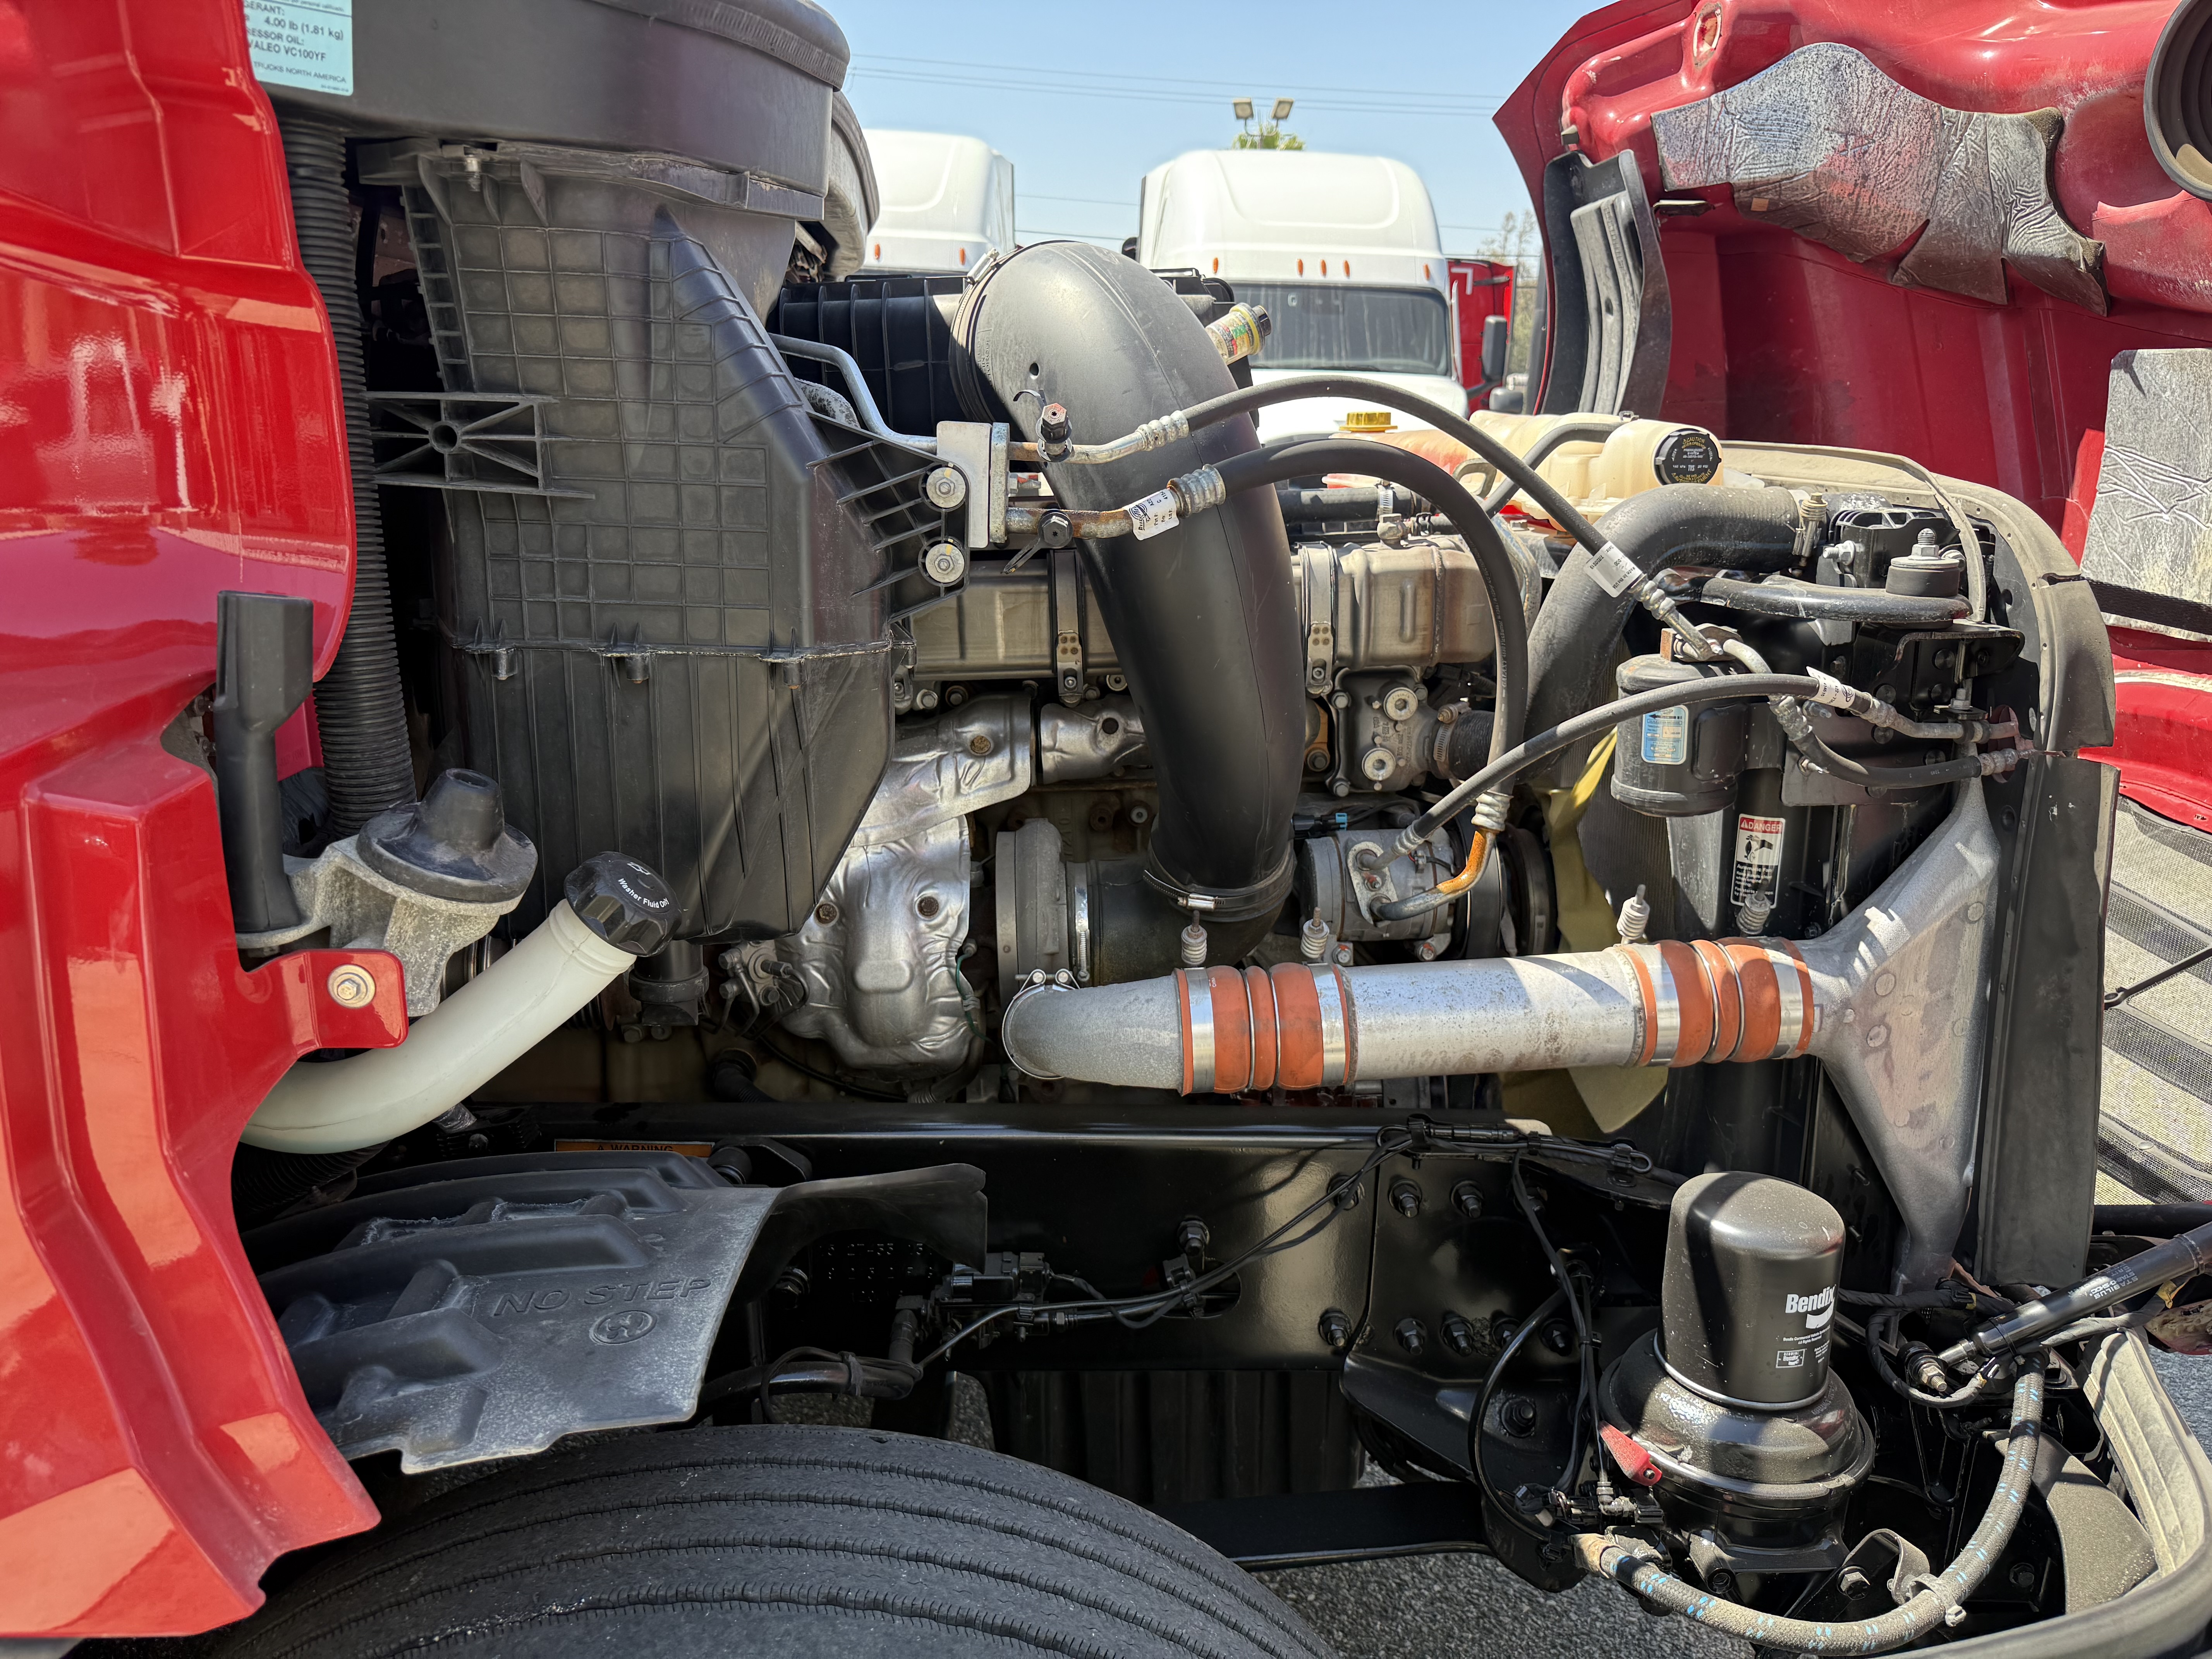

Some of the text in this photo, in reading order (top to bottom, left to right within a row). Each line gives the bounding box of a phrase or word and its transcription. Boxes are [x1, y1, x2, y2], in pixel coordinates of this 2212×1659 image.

[264, 16, 286, 28] 4.00
[289, 21, 298, 31] lb
[301, 22, 324, 35] (1.81
[328, 27, 343, 41] kg)
[283, 45, 326, 61] VC100YF
[253, 61, 347, 83] TRUCKS NORTH AMERICA
[1748, 821, 1782, 832] DANGER
[618, 878, 642, 901] Washer
[643, 898, 659, 908] Fluid
[491, 1279, 712, 1317] NO STEP
[1785, 1286, 1835, 1313] Bendix
[2094, 1277, 2138, 1299] STABILUS
